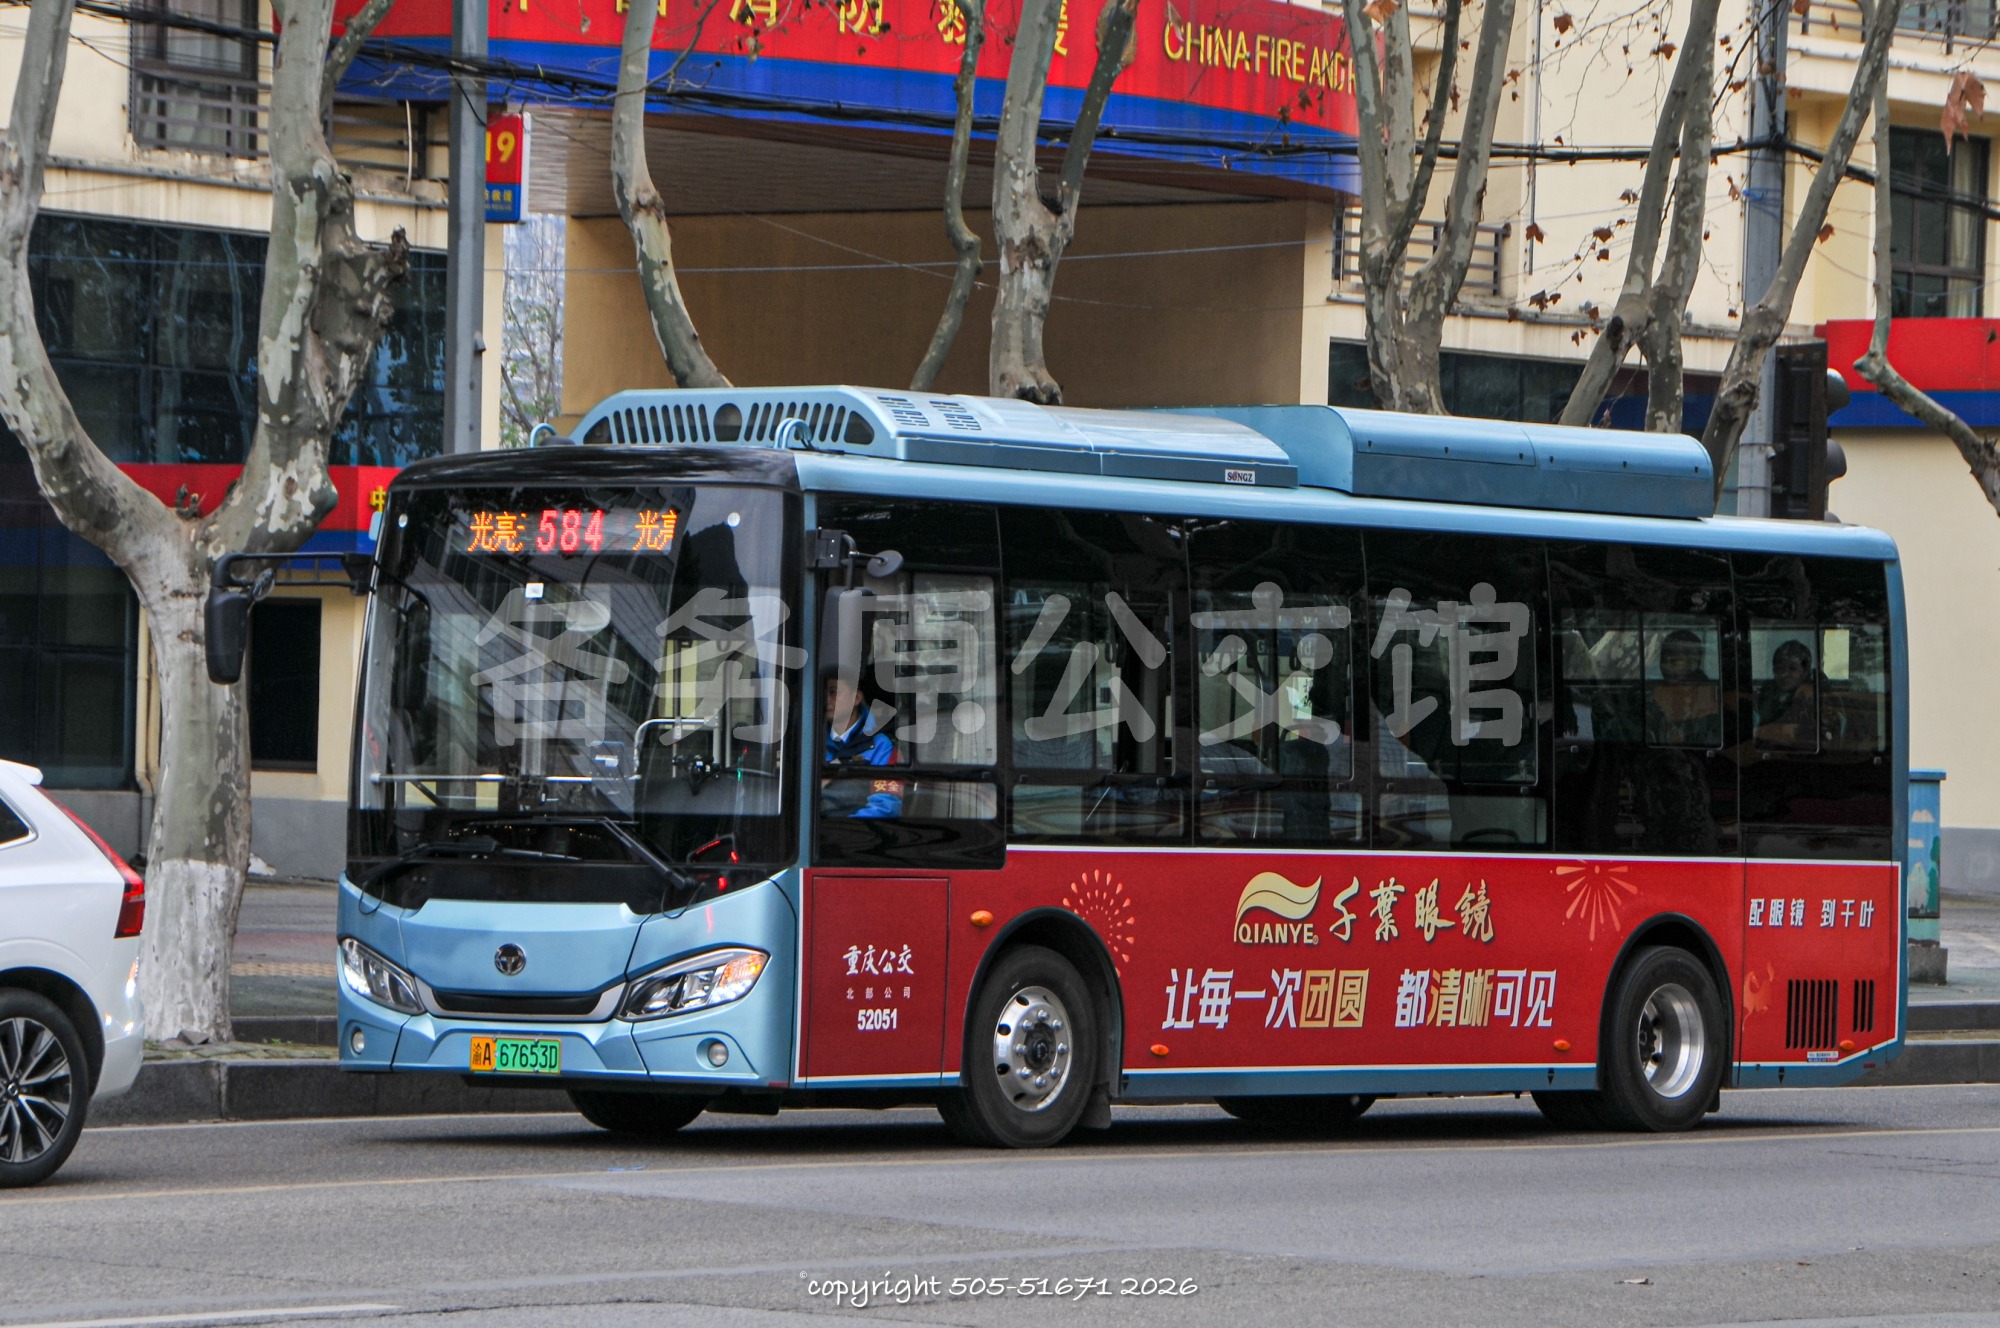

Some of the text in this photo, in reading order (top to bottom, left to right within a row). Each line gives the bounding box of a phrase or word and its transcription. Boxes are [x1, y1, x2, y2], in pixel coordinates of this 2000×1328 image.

[1165, 21, 1250, 72] CHINA
[1255, 34, 1306, 82] FIRE
[1308, 46, 1345, 91] AND
[486, 131, 515, 162] 19
[1227, 471, 1253, 482] SONGZ
[536, 508, 605, 552] 584
[1748, 898, 1805, 926] 配眼镜
[1238, 923, 1314, 944] QIANYE
[842, 944, 914, 975] 重庆公交
[846, 986, 911, 999] 北部公司
[1162, 968, 1557, 1029] 让每一次团圆 都清晰可见
[857, 1008, 898, 1030] 52051
